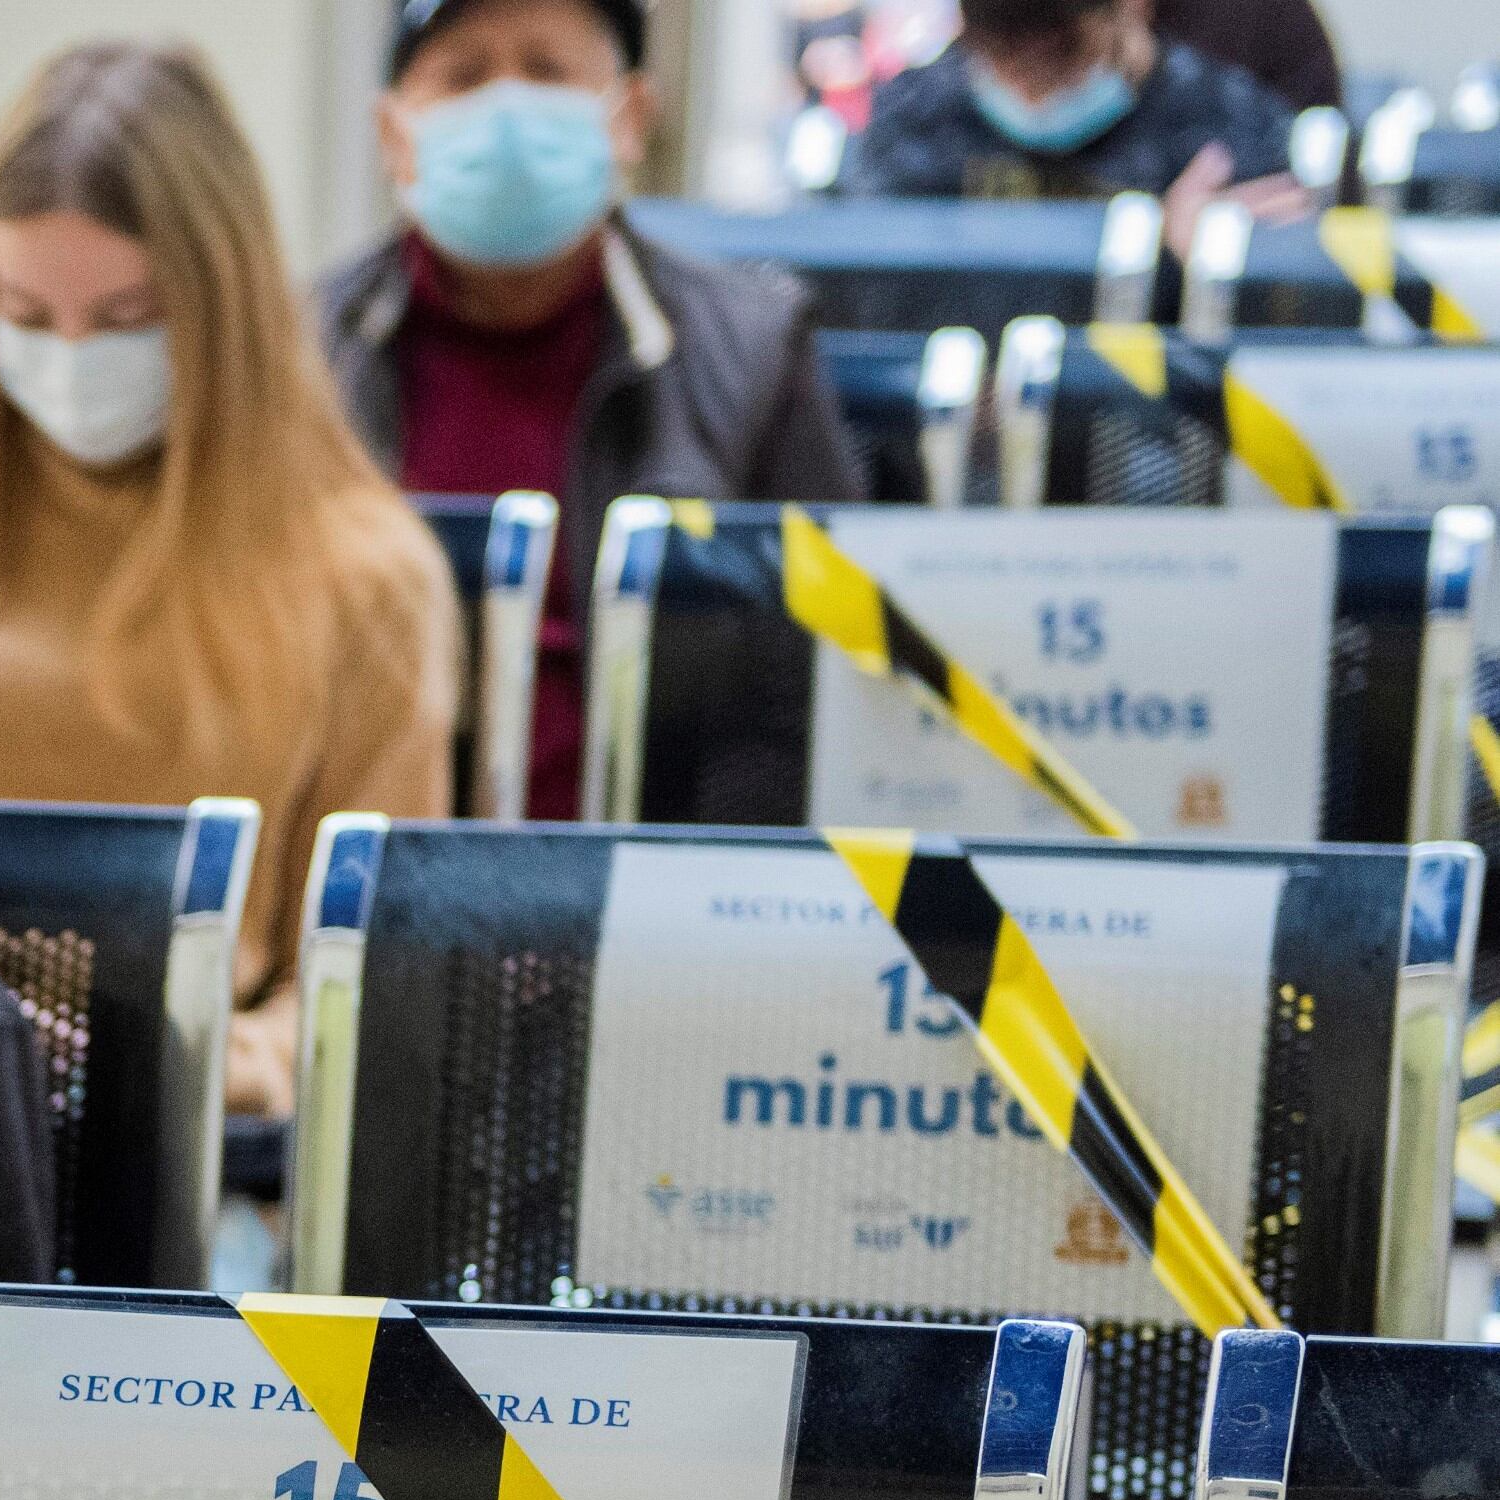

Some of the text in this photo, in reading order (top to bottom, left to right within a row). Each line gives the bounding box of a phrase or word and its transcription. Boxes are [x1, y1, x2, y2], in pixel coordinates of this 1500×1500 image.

[1038, 599, 1105, 664] 15
[59, 1373, 237, 1408] SECTOR
[568, 1398, 631, 1427] DE
